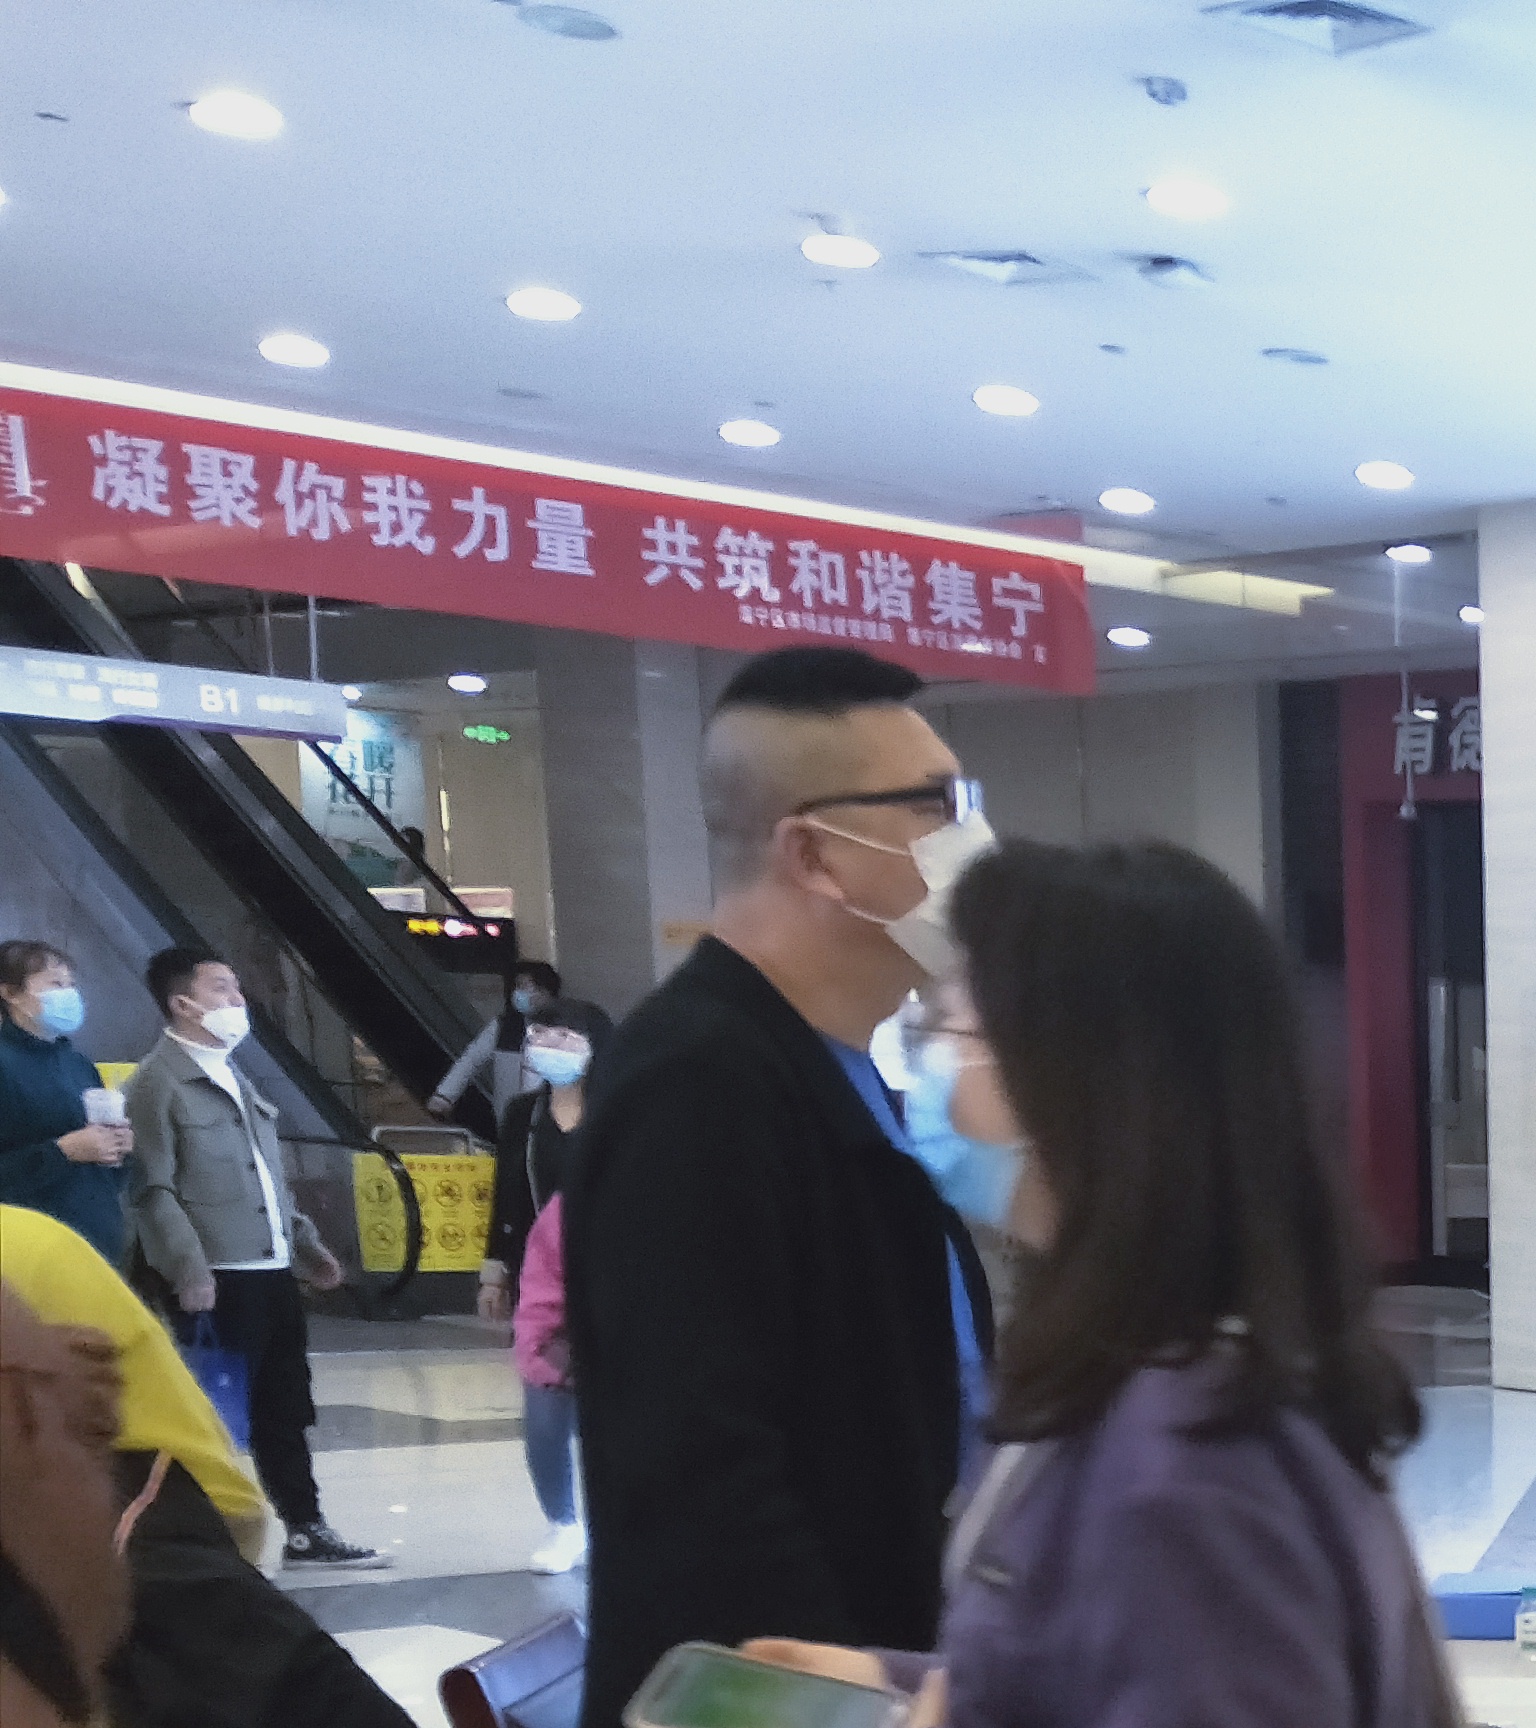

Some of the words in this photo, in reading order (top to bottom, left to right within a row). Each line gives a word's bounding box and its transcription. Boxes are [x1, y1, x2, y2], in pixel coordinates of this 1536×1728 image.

[88, 428, 595, 577] 凝聚你我力量
[641, 514, 1045, 637] 共筑和谐集宁
[200, 684, 240, 715] B1
